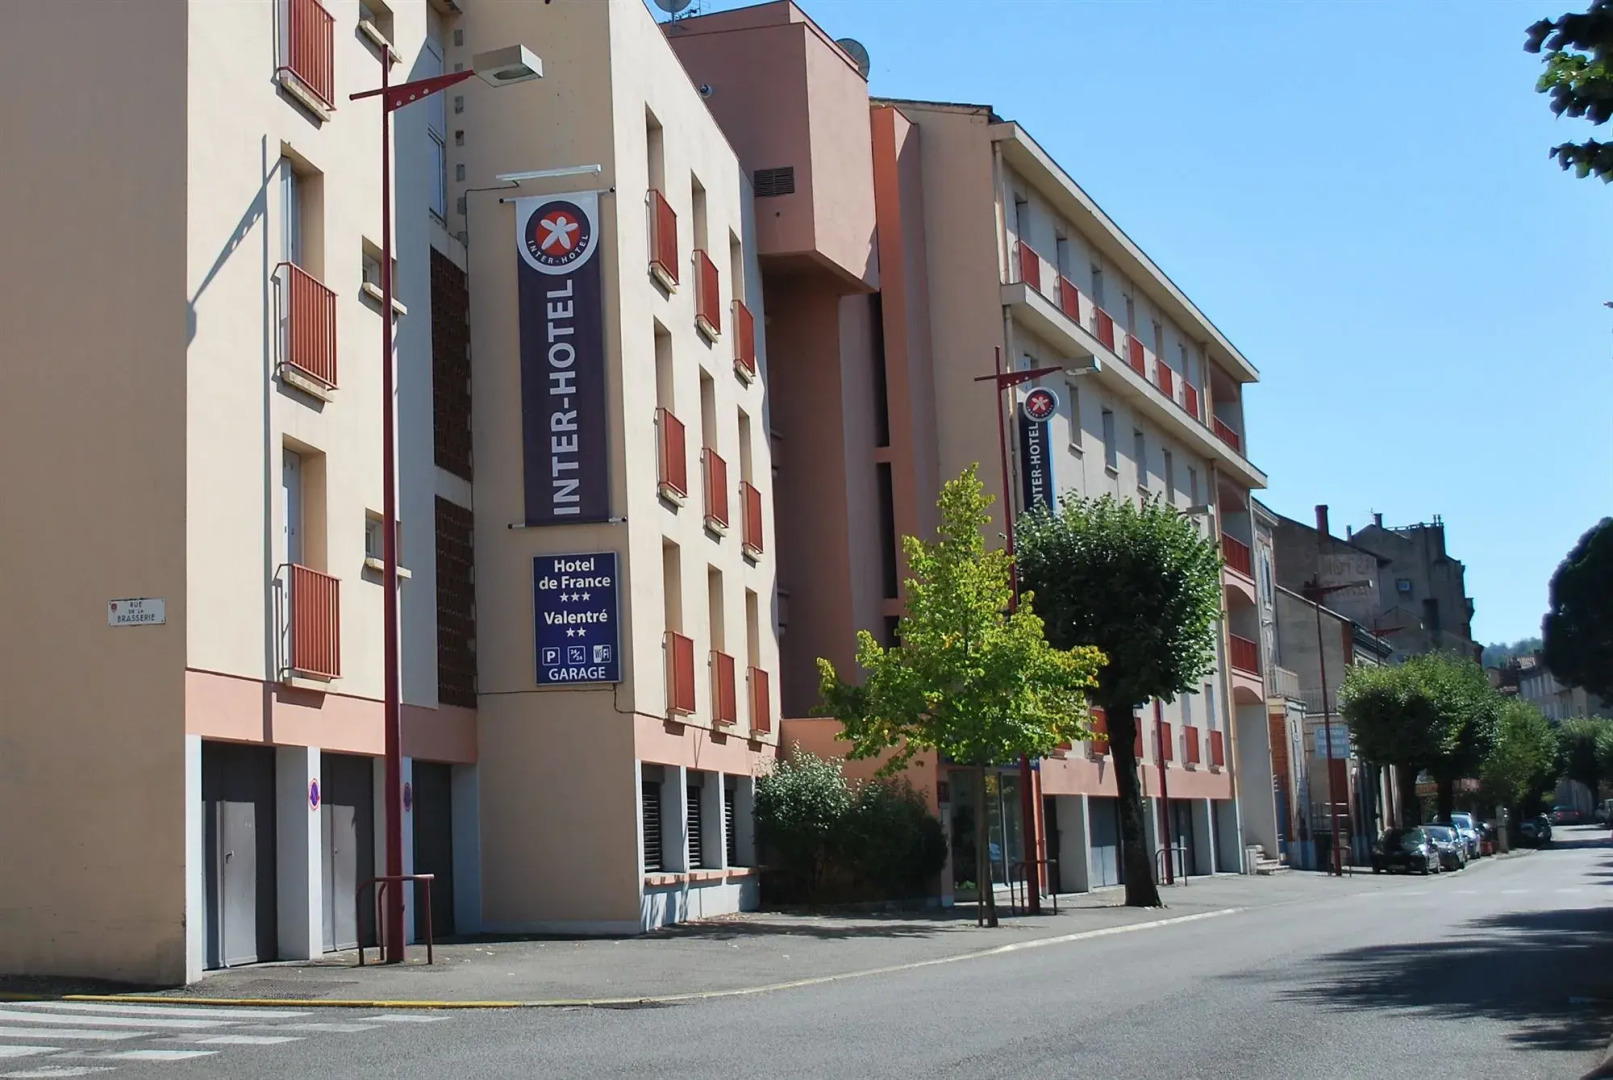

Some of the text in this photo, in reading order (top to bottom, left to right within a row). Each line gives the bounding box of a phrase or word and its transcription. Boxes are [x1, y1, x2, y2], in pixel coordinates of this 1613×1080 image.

[528, 234, 589, 264] INTER-HOTEL
[547, 279, 581, 516] INTER-HOTEL
[554, 557, 594, 573] Hotel
[539, 575, 611, 590] de France
[117, 614, 155, 623] BRASSERIE
[544, 608, 608, 625] Valentré
[546, 651, 556, 662] P
[548, 666, 606, 681] GARAGE
